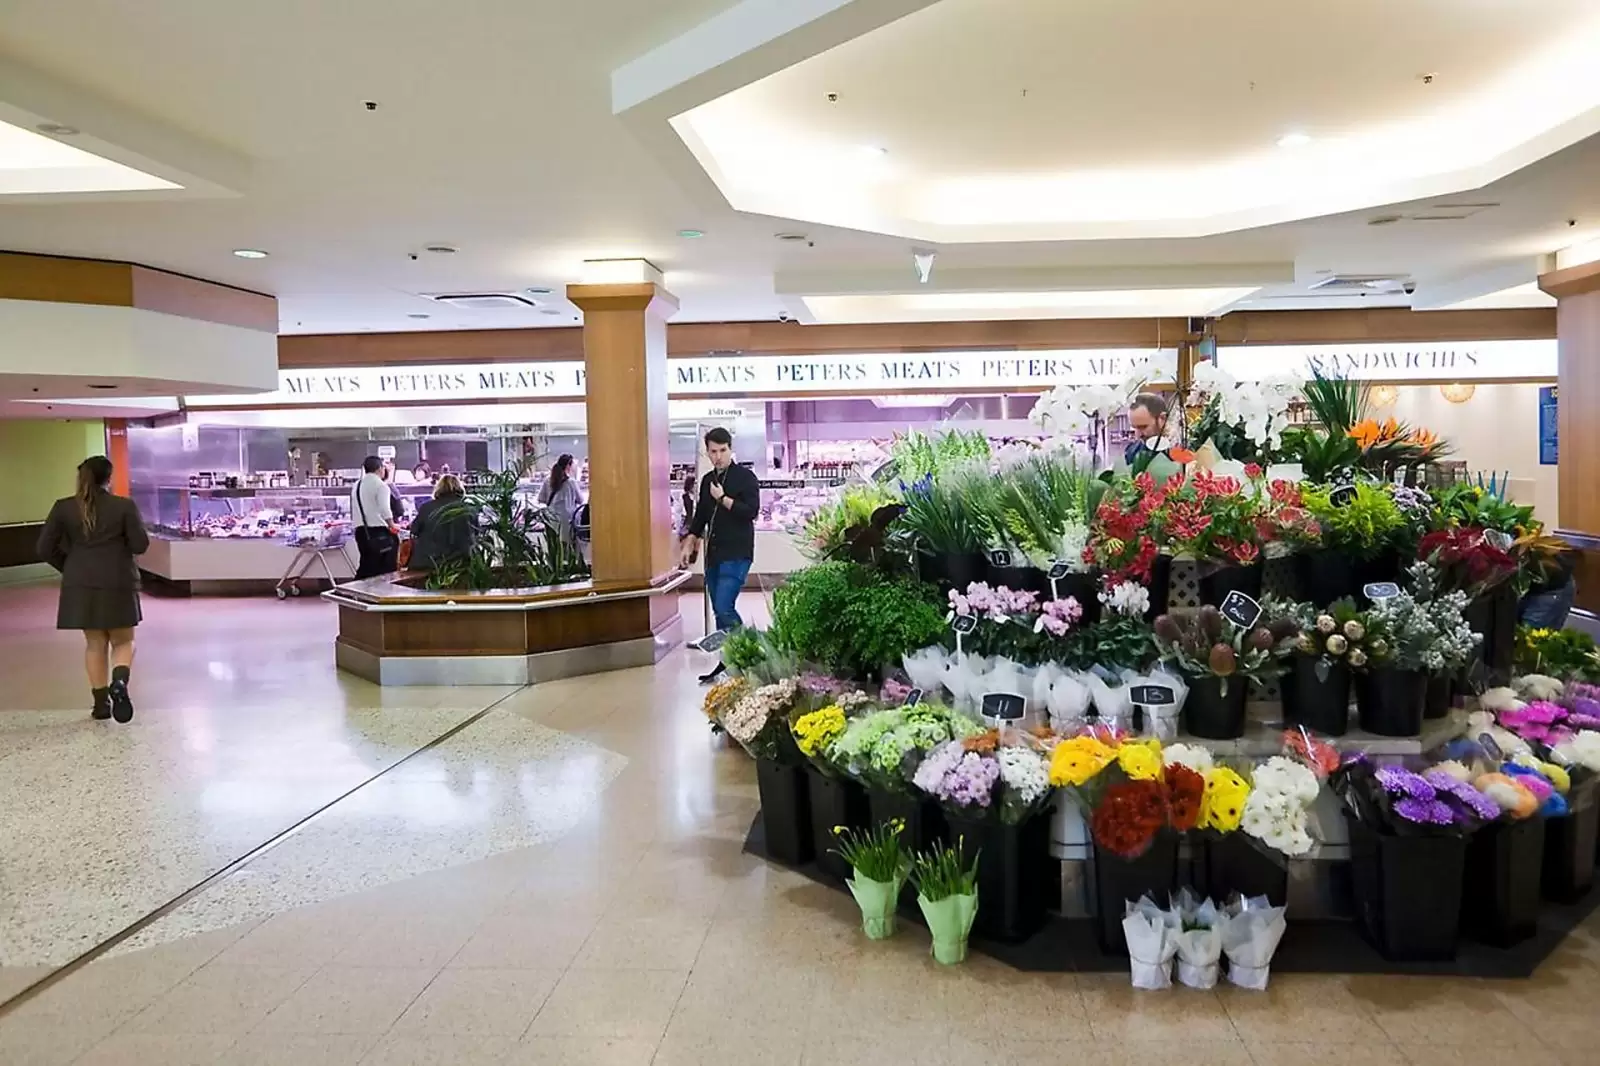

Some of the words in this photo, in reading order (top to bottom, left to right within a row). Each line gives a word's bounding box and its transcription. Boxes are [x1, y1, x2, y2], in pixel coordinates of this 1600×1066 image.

[677, 364, 756, 383] MEATS
[776, 362, 867, 382] PETERS
[881, 360, 961, 379] MEATS
[982, 358, 1073, 377] PETERS
[1087, 357, 1149, 376] MEA
[1311, 349, 1479, 372] SANDWICHES
[285, 375, 361, 393] MEATS
[380, 372, 467, 391] PETERS
[478, 369, 557, 390] MEATS
[995, 551, 1007, 565] 12
[1143, 687, 1165, 703] 13
[998, 699, 1010, 713] 11
